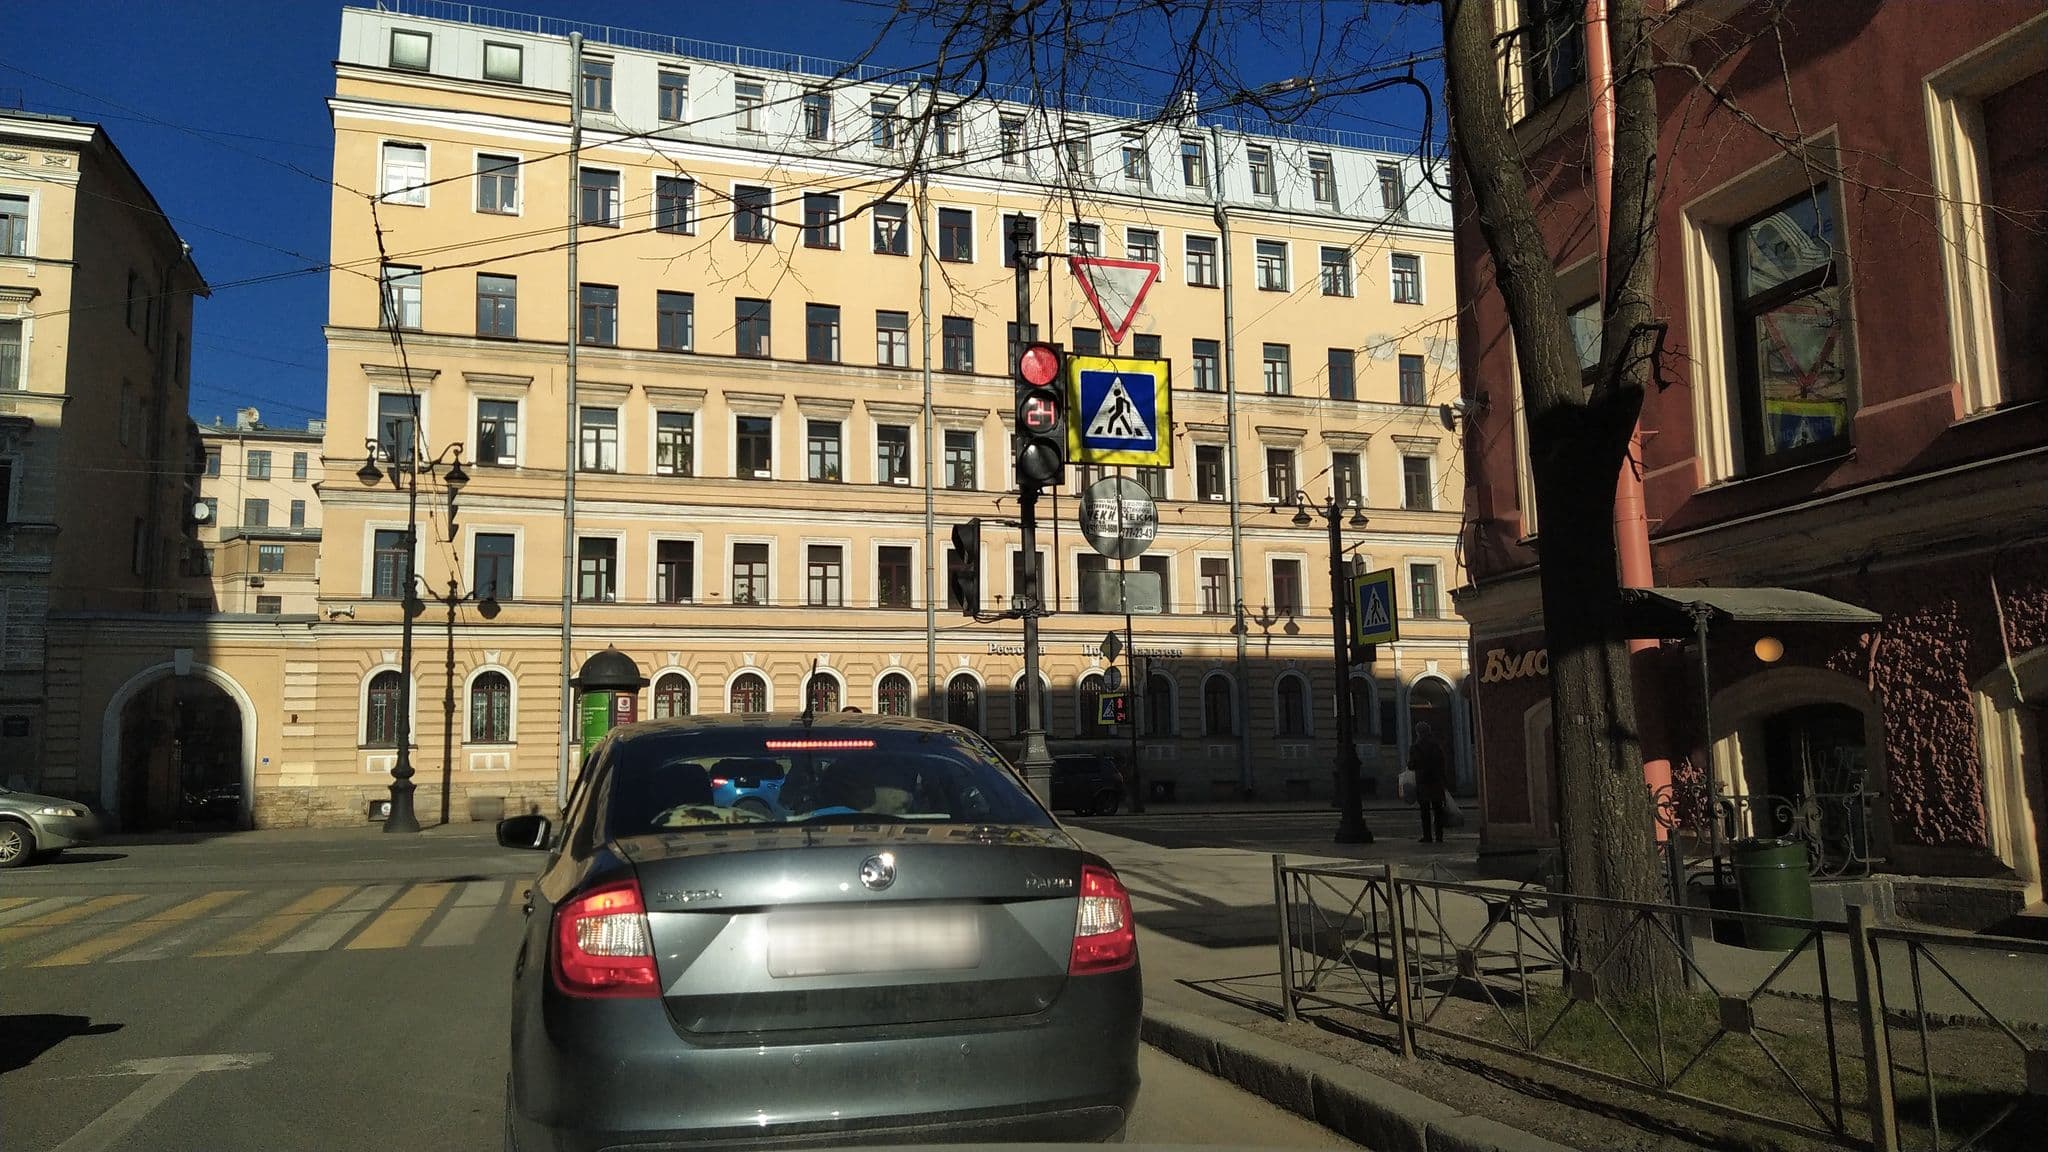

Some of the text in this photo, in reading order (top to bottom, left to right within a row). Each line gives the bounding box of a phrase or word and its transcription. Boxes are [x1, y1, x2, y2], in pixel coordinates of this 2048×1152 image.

[1027, 399, 1055, 425] 24
[988, 643, 1046, 656] Рестон
[1480, 648, 1549, 683] Було
